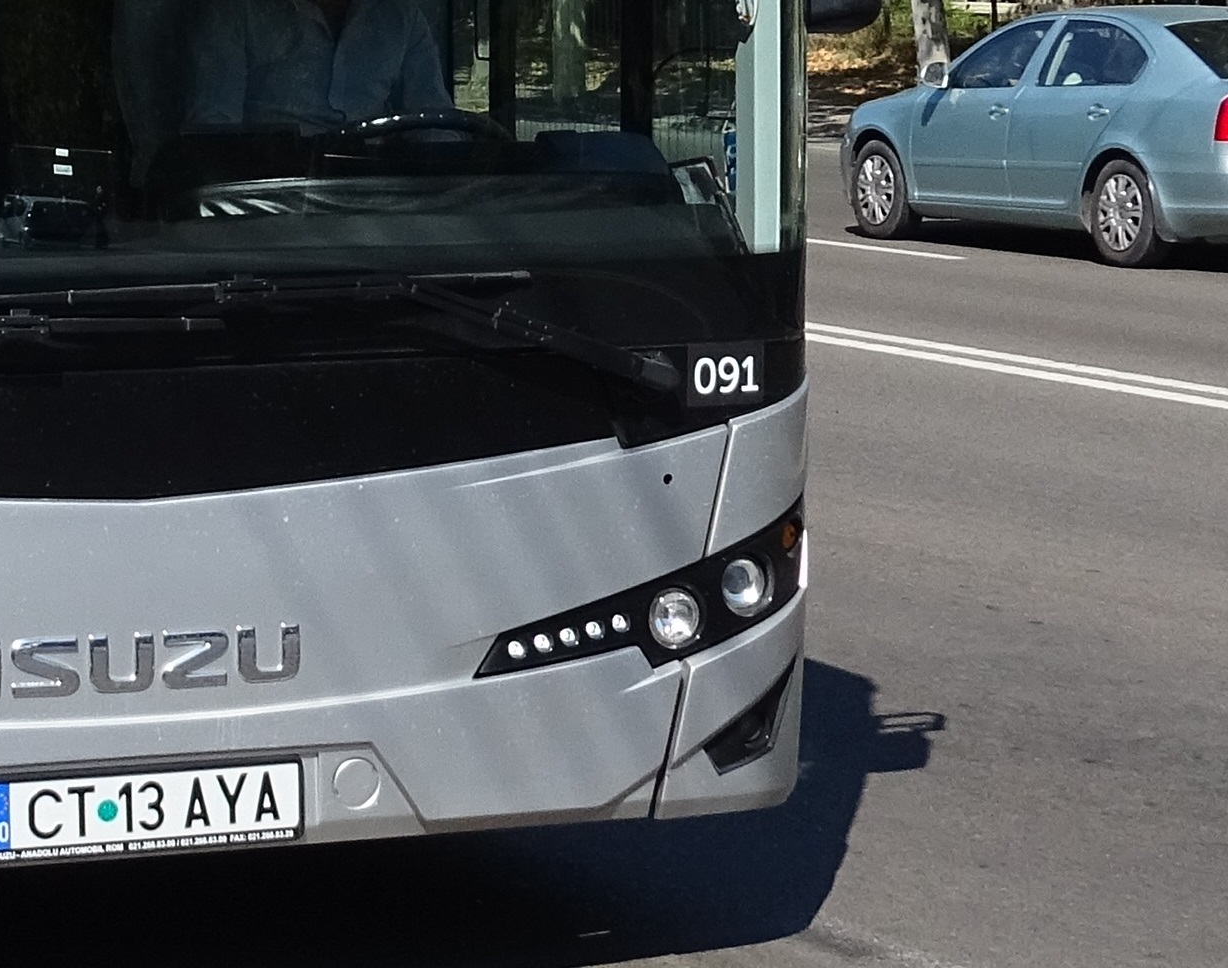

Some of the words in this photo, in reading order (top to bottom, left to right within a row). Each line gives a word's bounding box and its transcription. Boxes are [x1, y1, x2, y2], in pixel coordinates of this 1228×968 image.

[694, 355, 760, 395] 091
[27, 785, 96, 840] CT
[118, 780, 165, 833] 13
[184, 770, 281, 829] AYA
